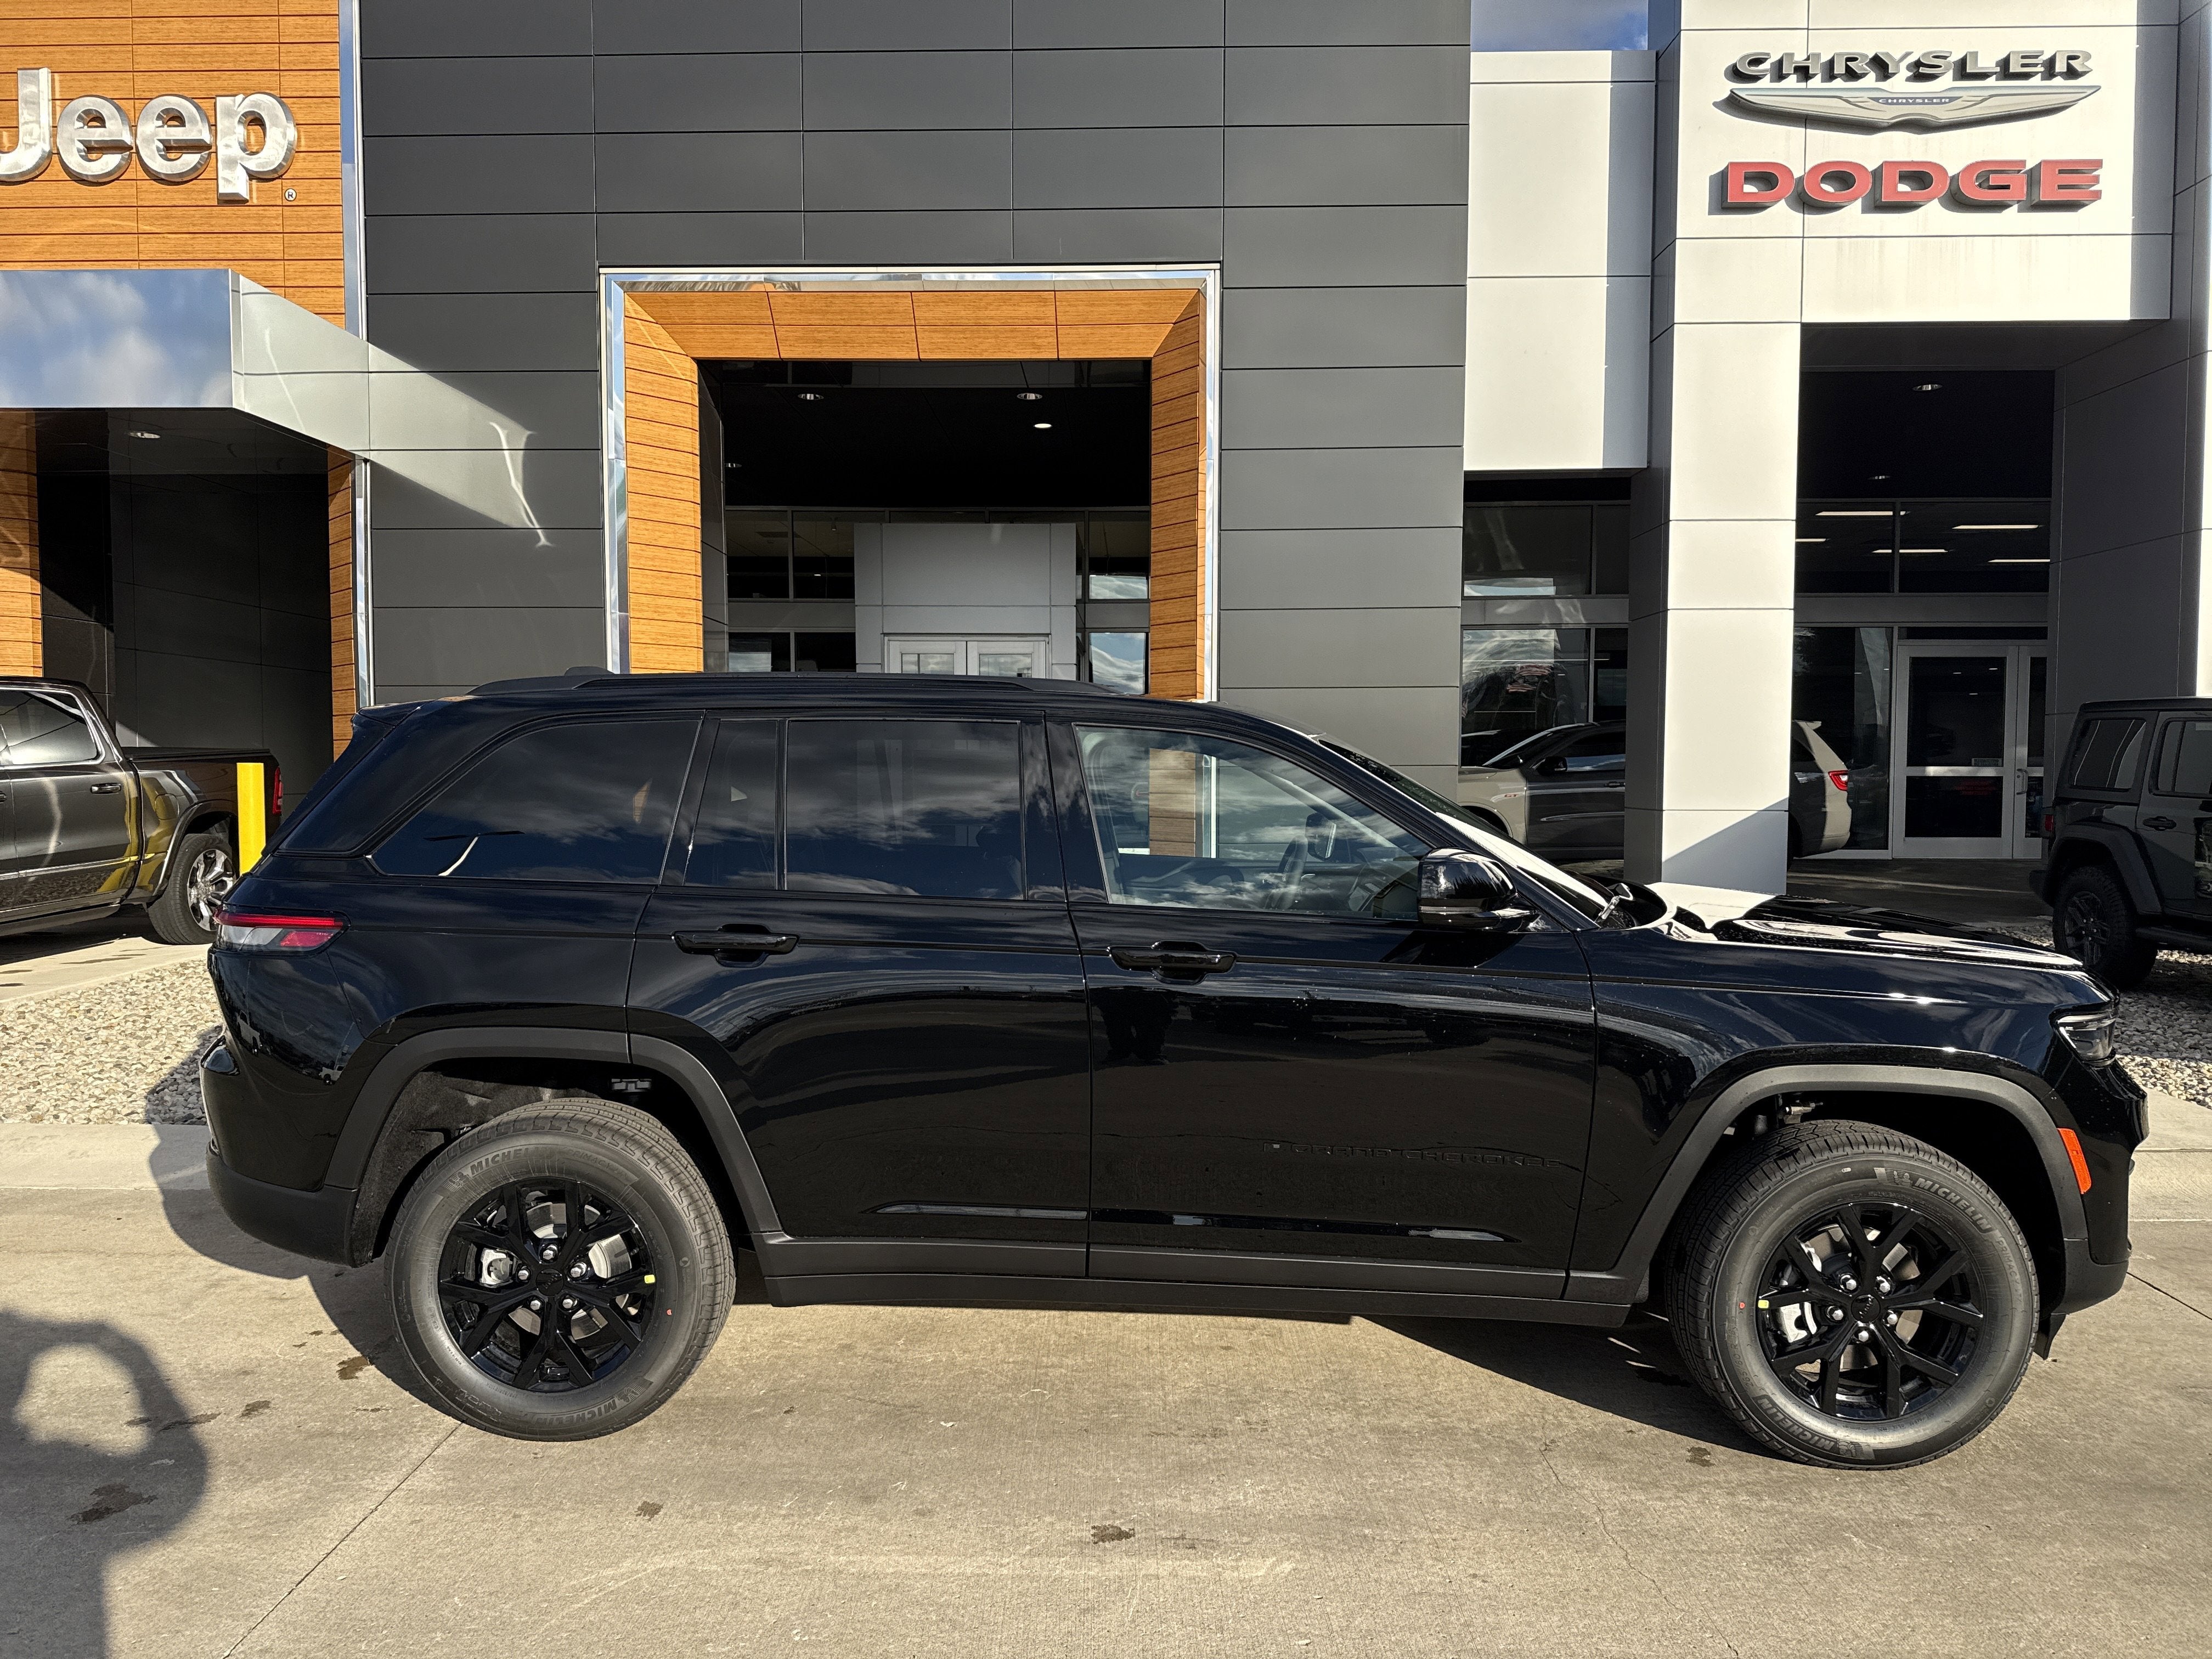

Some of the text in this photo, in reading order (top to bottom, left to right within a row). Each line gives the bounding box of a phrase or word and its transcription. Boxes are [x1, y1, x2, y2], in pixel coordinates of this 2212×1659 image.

[1735, 49, 2093, 76] CHRYSLER
[0, 67, 297, 204] Jeep
[1725, 159, 2103, 204] DODGE
[1291, 1143, 1561, 1168] GRAND CHEROKEE
[1914, 1177, 1992, 1230] MICHELIN
[1757, 1398, 1835, 1450] MICHELIN
